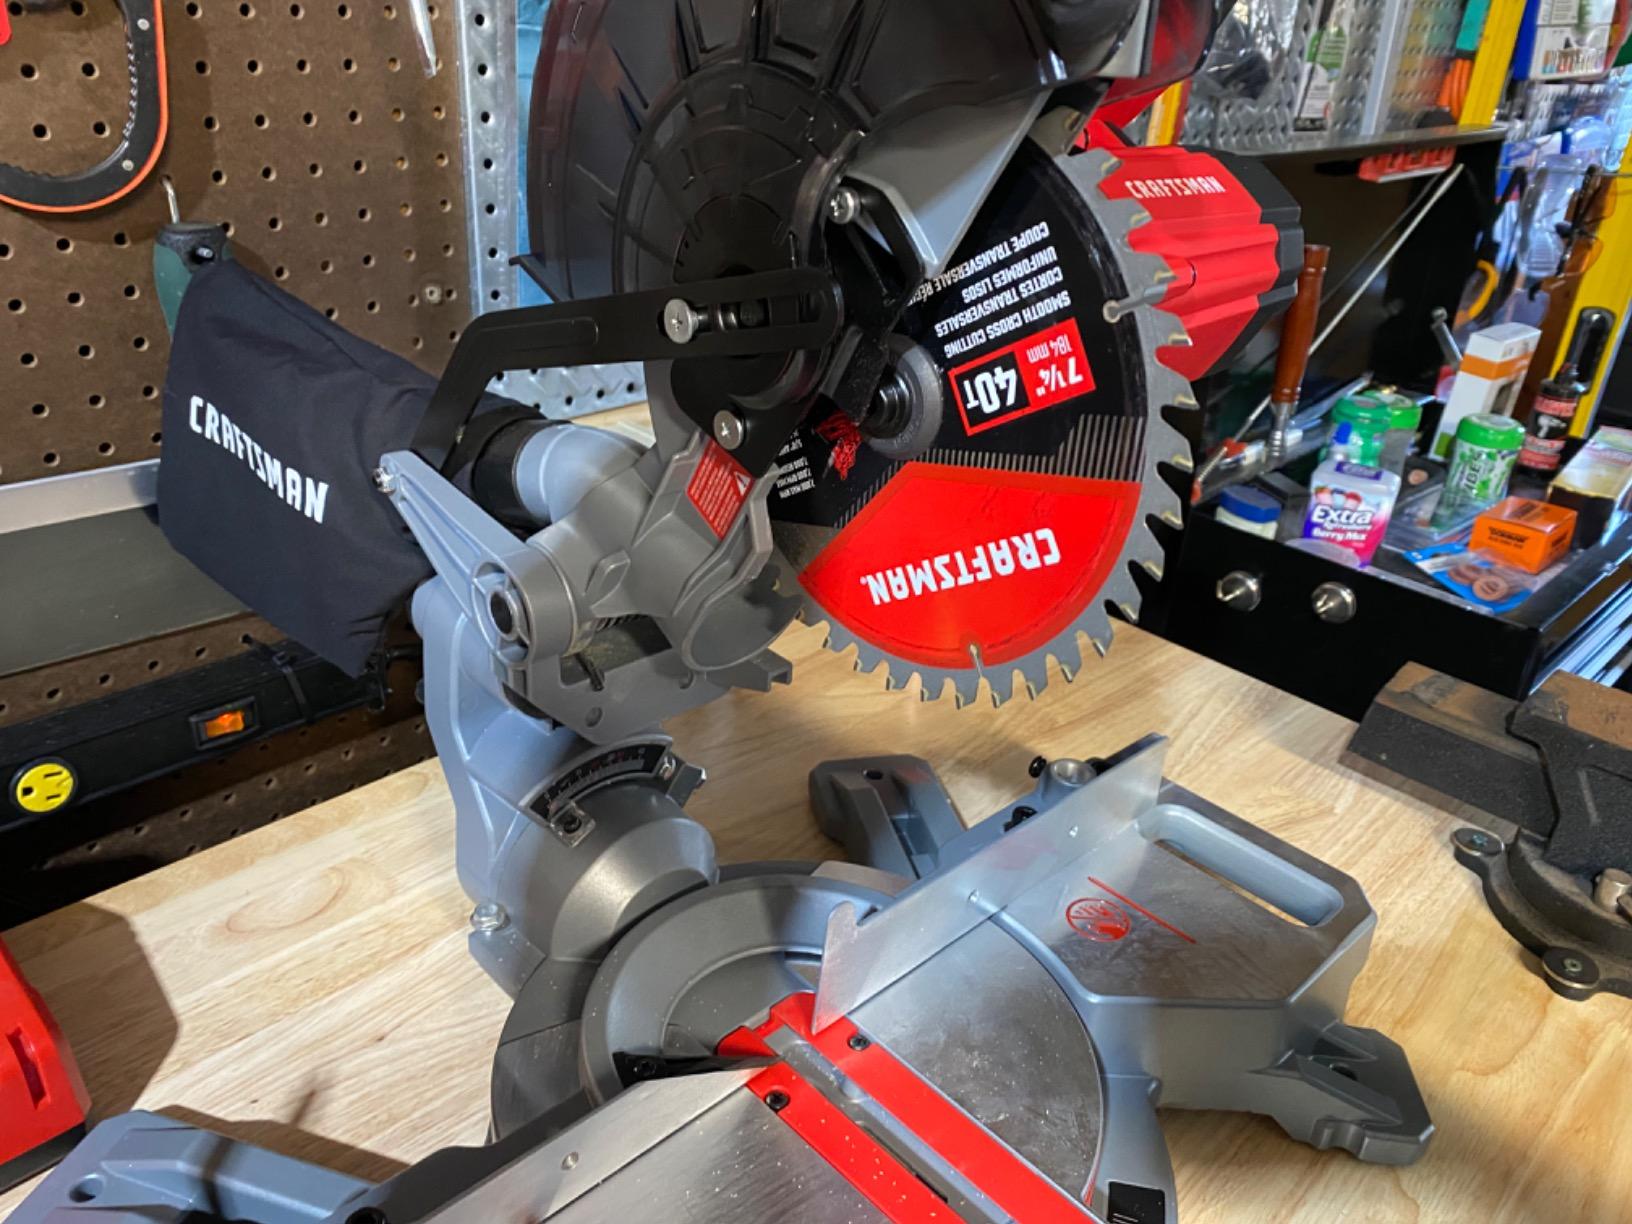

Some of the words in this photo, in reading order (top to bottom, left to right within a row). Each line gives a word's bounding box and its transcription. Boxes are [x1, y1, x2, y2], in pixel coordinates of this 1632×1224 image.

[1125, 176, 1225, 198] CRAFTSMAN
[1010, 221, 1050, 252] COUPE
[932, 241, 1012, 291] TRANSVERSALE
[991, 246, 1058, 288] UNIFORMES
[961, 277, 994, 303] LISOS
[1018, 266, 1064, 298] CORTES
[934, 287, 1020, 337] TRANSVERSALES
[1021, 290, 1072, 323] SMOOTH
[985, 312, 1024, 339] CROSS
[943, 328, 987, 358] CUTTING
[1026, 342, 1050, 363] mm
[1050, 334, 1072, 356] 184
[963, 366, 1017, 413] 40T
[189, 394, 329, 524] CRAFTSMAN
[1312, 505, 1373, 525] Extra
